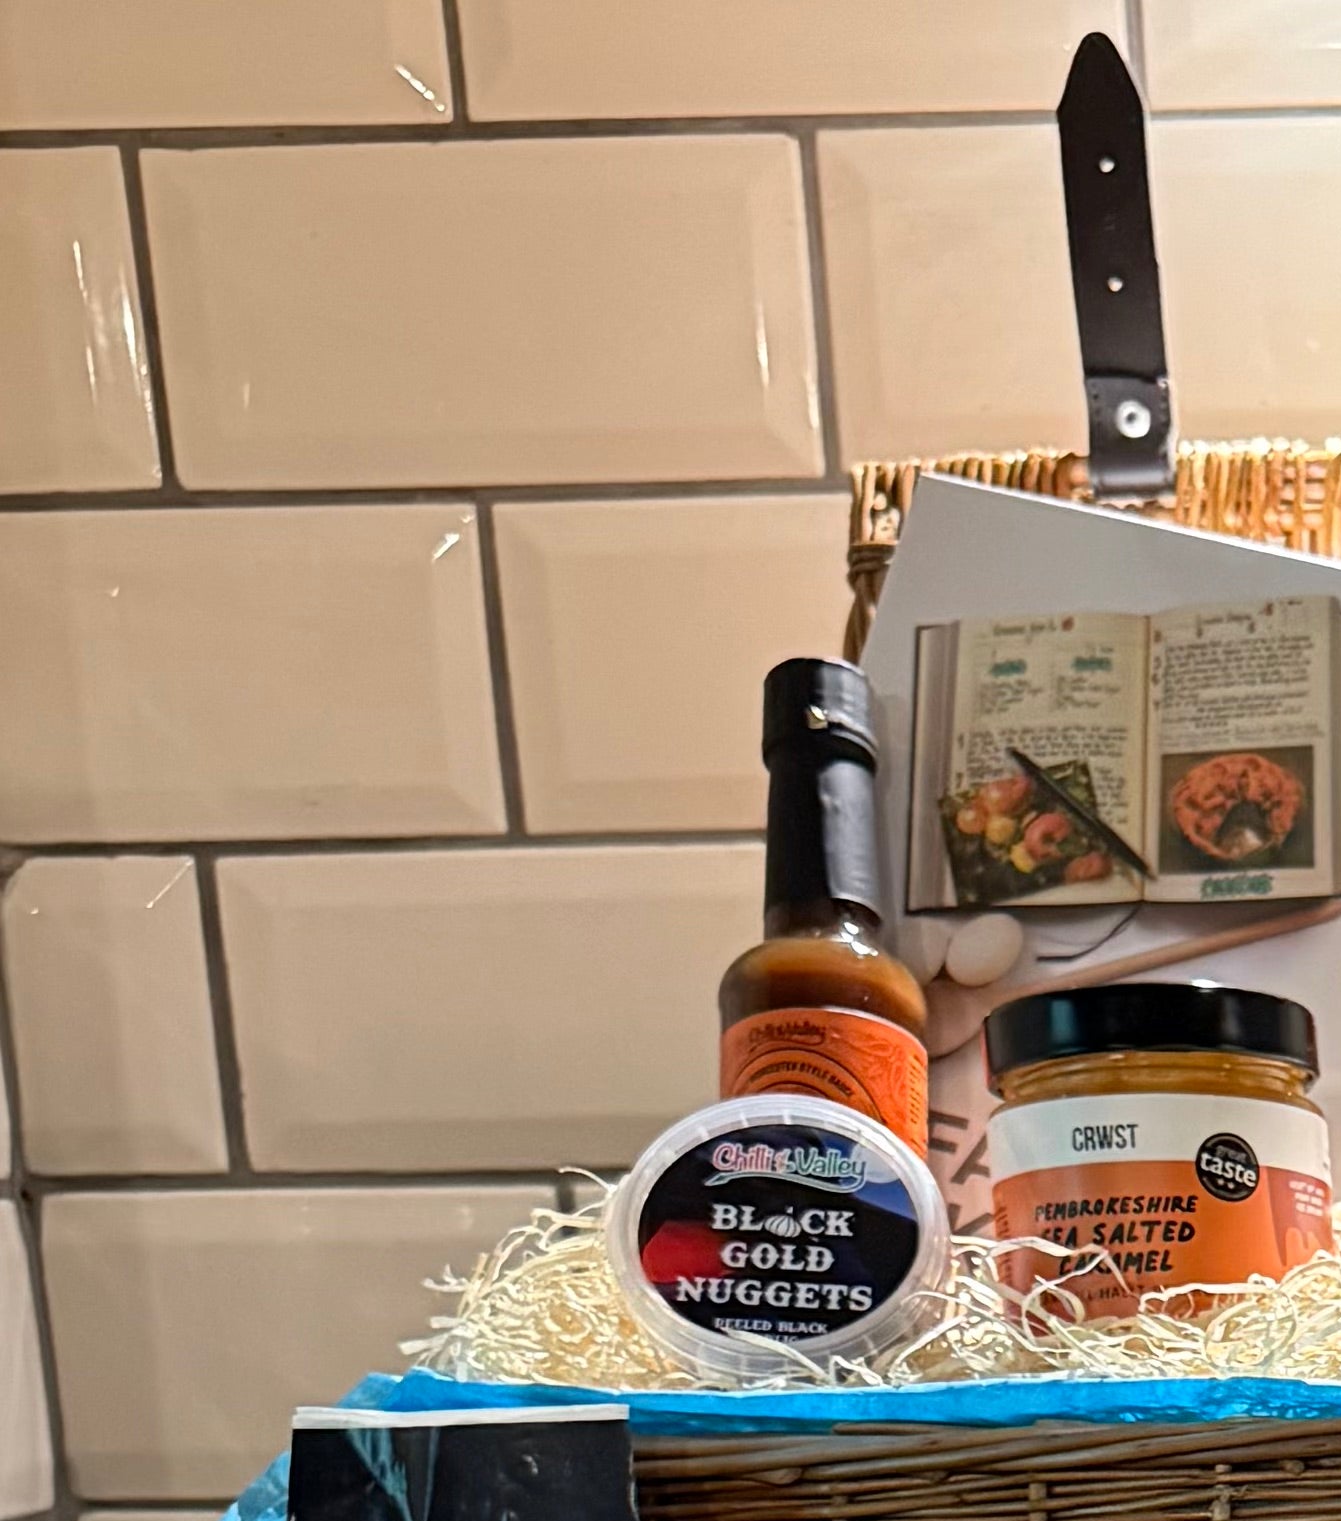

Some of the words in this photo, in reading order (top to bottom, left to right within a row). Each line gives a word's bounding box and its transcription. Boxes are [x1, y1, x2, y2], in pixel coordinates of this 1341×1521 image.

[1071, 1124, 1139, 1151] CRWST
[712, 1143, 774, 1172] Chilli
[794, 1147, 867, 1193] Valley
[1201, 1151, 1257, 1188] taste
[1035, 1194, 1200, 1222] PEMBROKESHIRE
[1092, 1220, 1197, 1245] SALTED
[720, 1241, 836, 1273] GOLD
[675, 1276, 874, 1312] NUGGETS
[713, 1316, 773, 1332] PEELED
[777, 1320, 829, 1334] BLACK
